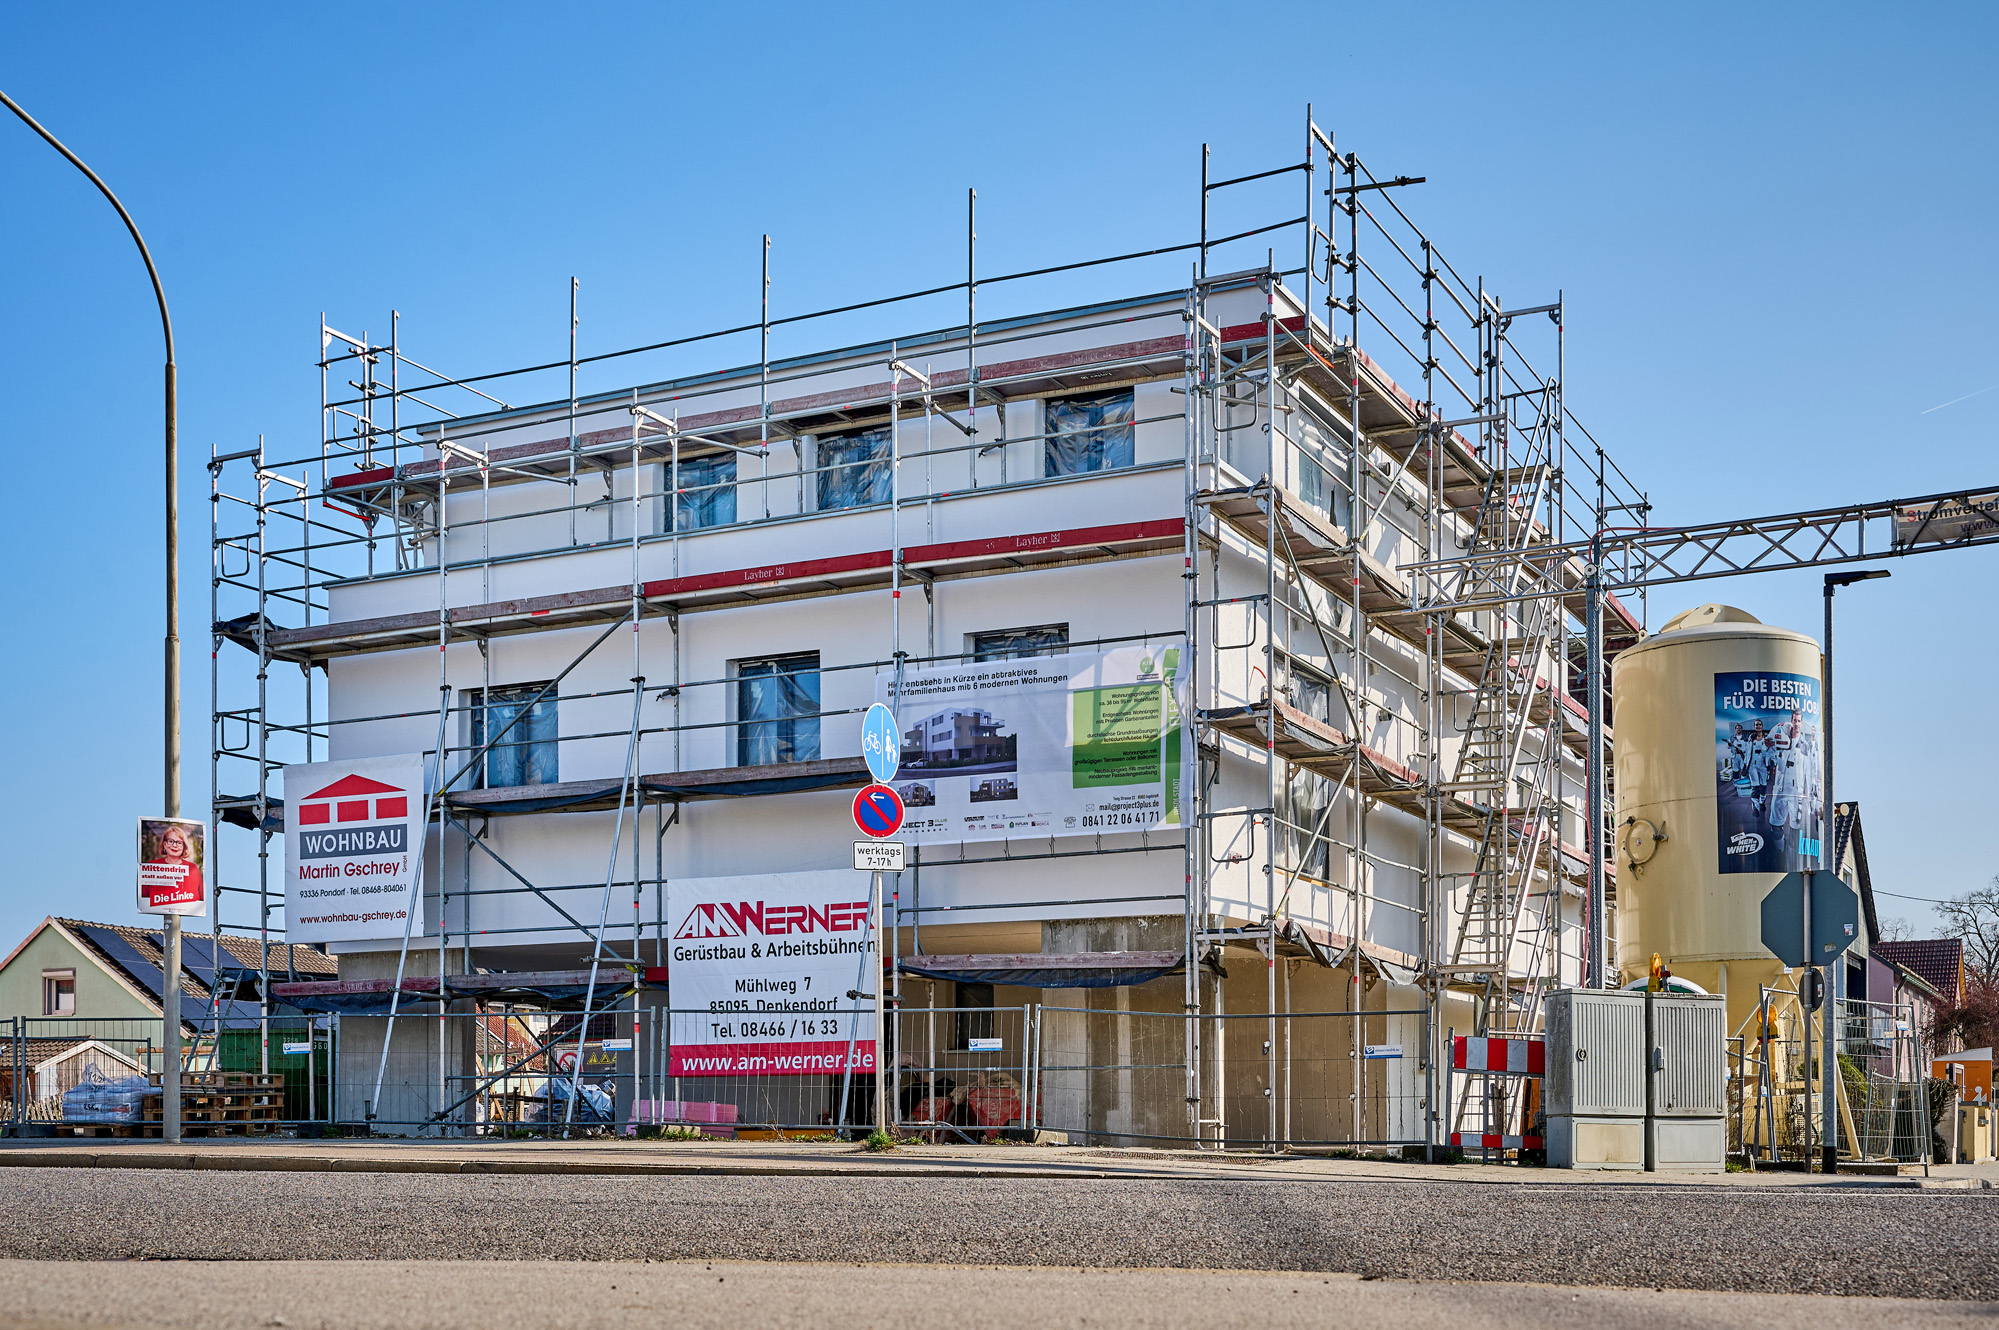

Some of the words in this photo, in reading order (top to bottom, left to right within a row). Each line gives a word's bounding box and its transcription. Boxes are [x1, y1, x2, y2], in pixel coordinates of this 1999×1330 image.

[1016, 536, 1047, 547] Layher
[744, 570, 772, 580] Layher
[906, 678, 942, 687] entsteht
[991, 669, 1038, 679] attraktives
[980, 679, 1018, 689] modernen
[1021, 675, 1068, 684] Wohnungen
[1744, 679, 1767, 692] DIE
[1771, 680, 1811, 697] BESTEN
[1724, 692, 1755, 710] FÜR
[1760, 696, 1799, 711] JEDEN
[1099, 800, 1159, 811] mail@project3plus.de
[1082, 815, 1104, 827] 0841
[1108, 814, 1118, 825] 22
[1121, 813, 1132, 824] 06
[1135, 812, 1146, 823] 41
[1150, 811, 1159, 822] 71
[306, 829, 400, 854] WOHNBAU
[1726, 844, 1756, 855] WHITE
[858, 847, 901, 857] werktags
[142, 865, 185, 873] Mittendrin
[300, 864, 340, 879] Martin
[344, 861, 400, 876] Gschrey
[154, 894, 169, 903] Die
[171, 890, 194, 901] Linke
[300, 890, 319, 898] 93336
[320, 888, 345, 897] Pondorf
[350, 887, 360, 895] Tel.
[362, 884, 406, 894] 08468-804061
[300, 910, 406, 924] www.wohnbau-gschrey.de
[675, 904, 738, 938] AM
[720, 901, 875, 937] WERNER
[674, 944, 746, 961] Gerüstbau
[751, 943, 761, 958] &
[766, 938, 875, 958] Arbeitsbühnen
[735, 979, 796, 994] Mühlweg
[804, 977, 811, 990] 7
[710, 1000, 749, 1014] 85095
[756, 997, 838, 1012] Denkendorf
[711, 1023, 736, 1038] Tel.
[741, 1021, 785, 1037] 08466
[790, 1019, 798, 1038] /
[802, 1020, 815, 1035] 16
[821, 1020, 838, 1035] 33
[682, 1048, 874, 1071] www.am-werner.de
